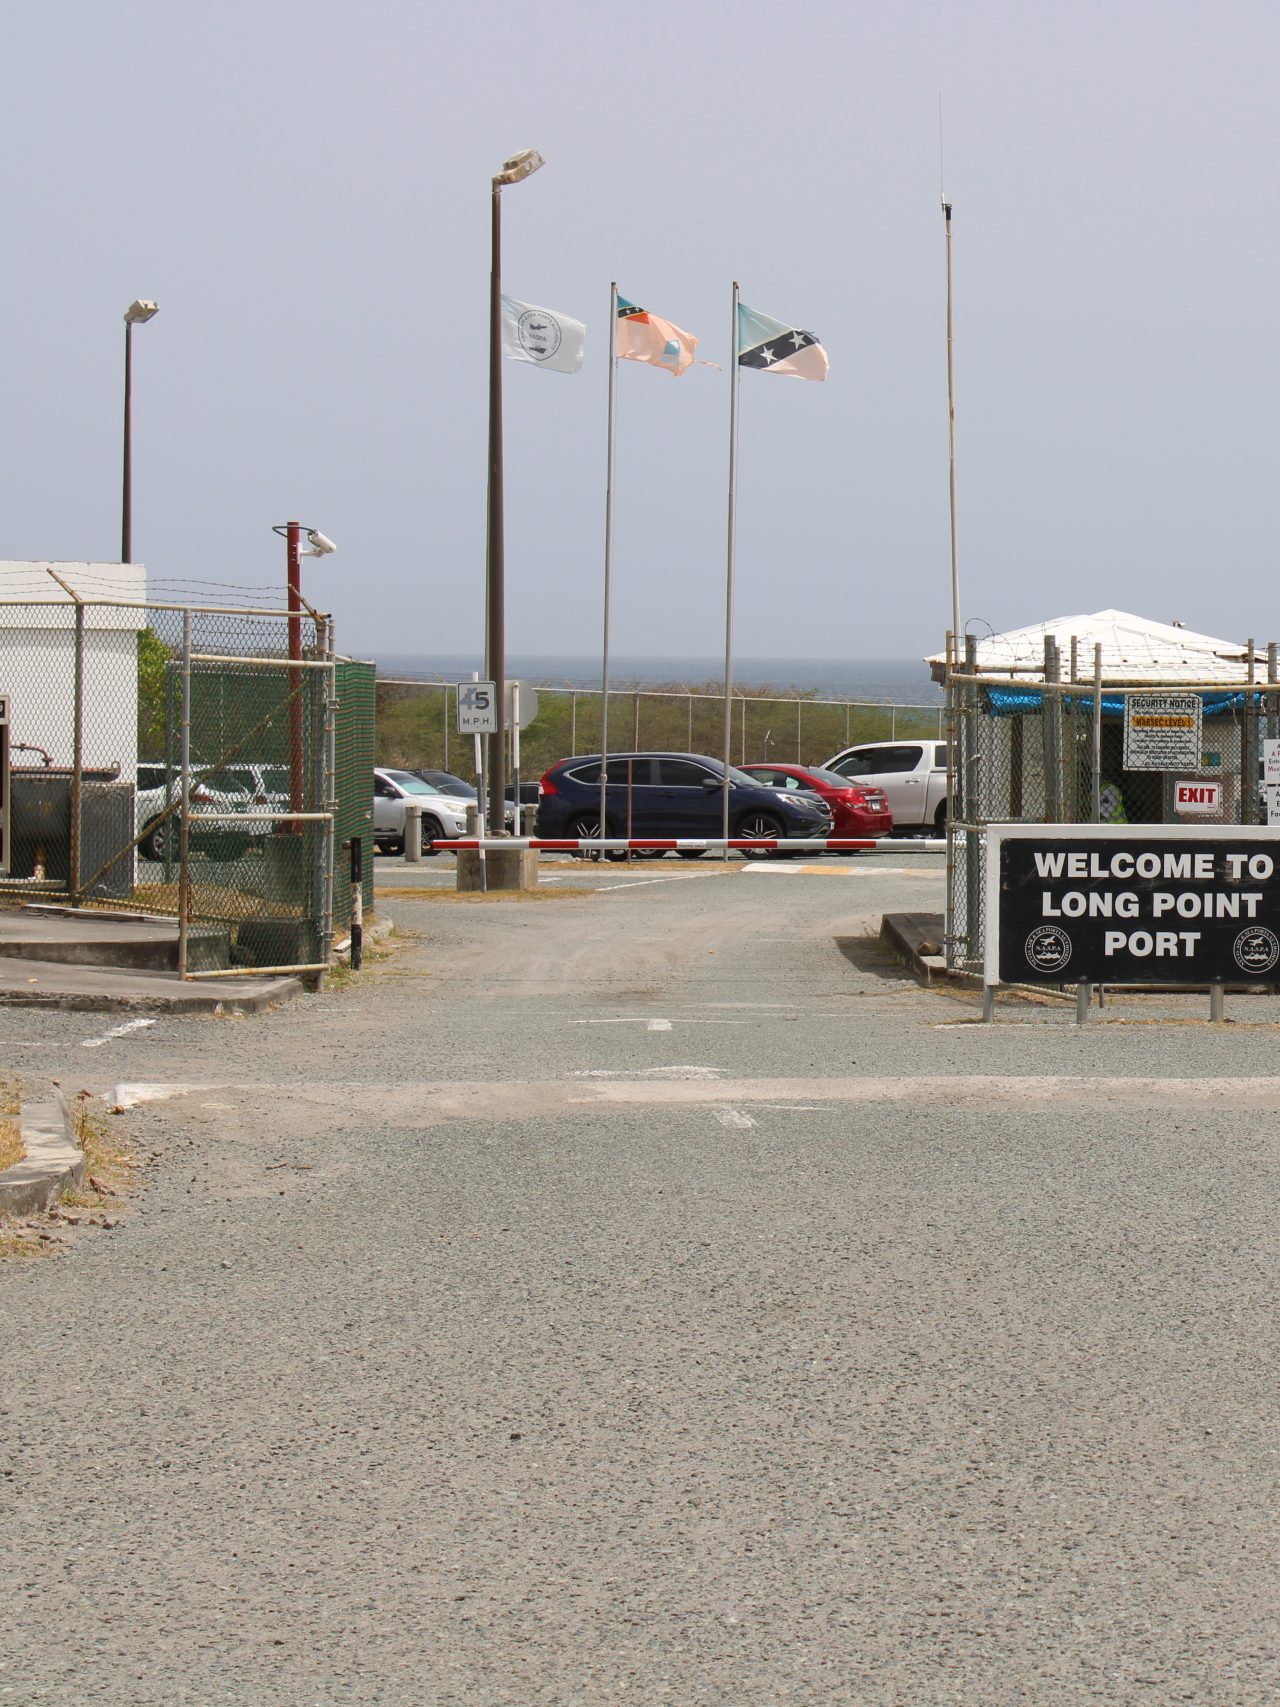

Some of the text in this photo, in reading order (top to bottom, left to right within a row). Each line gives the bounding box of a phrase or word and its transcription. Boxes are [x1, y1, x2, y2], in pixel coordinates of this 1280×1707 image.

[1132, 698, 1196, 708] SECURITY NOTICE
[1179, 788, 1216, 803] EXIT
[1034, 852, 1274, 879] WELCOME TO
[1042, 891, 1262, 918] LONG POINT
[1104, 931, 1201, 957] PORT
